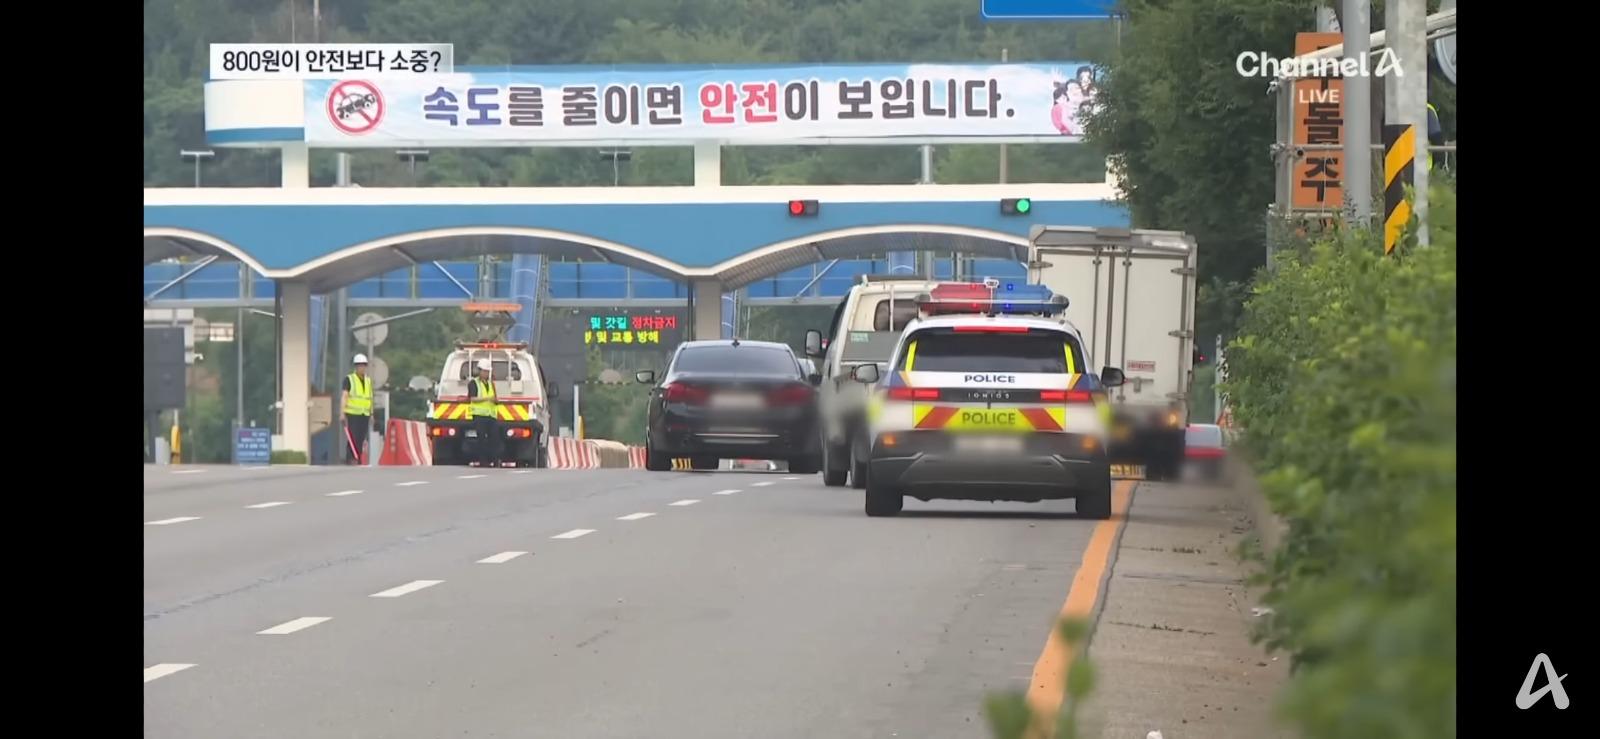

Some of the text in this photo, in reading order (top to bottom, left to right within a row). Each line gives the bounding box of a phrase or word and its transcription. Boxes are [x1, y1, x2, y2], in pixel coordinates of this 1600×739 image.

[423, 76, 1015, 126] 속도를 줄이면 안전이 보입니다.
[606, 317, 627, 329] 갓길
[632, 316, 675, 329] 정차금지
[610, 331, 633, 343] 교통
[637, 331, 659, 343] 방해
[964, 374, 1016, 384] POLICE
[962, 412, 1016, 425] POLICE
